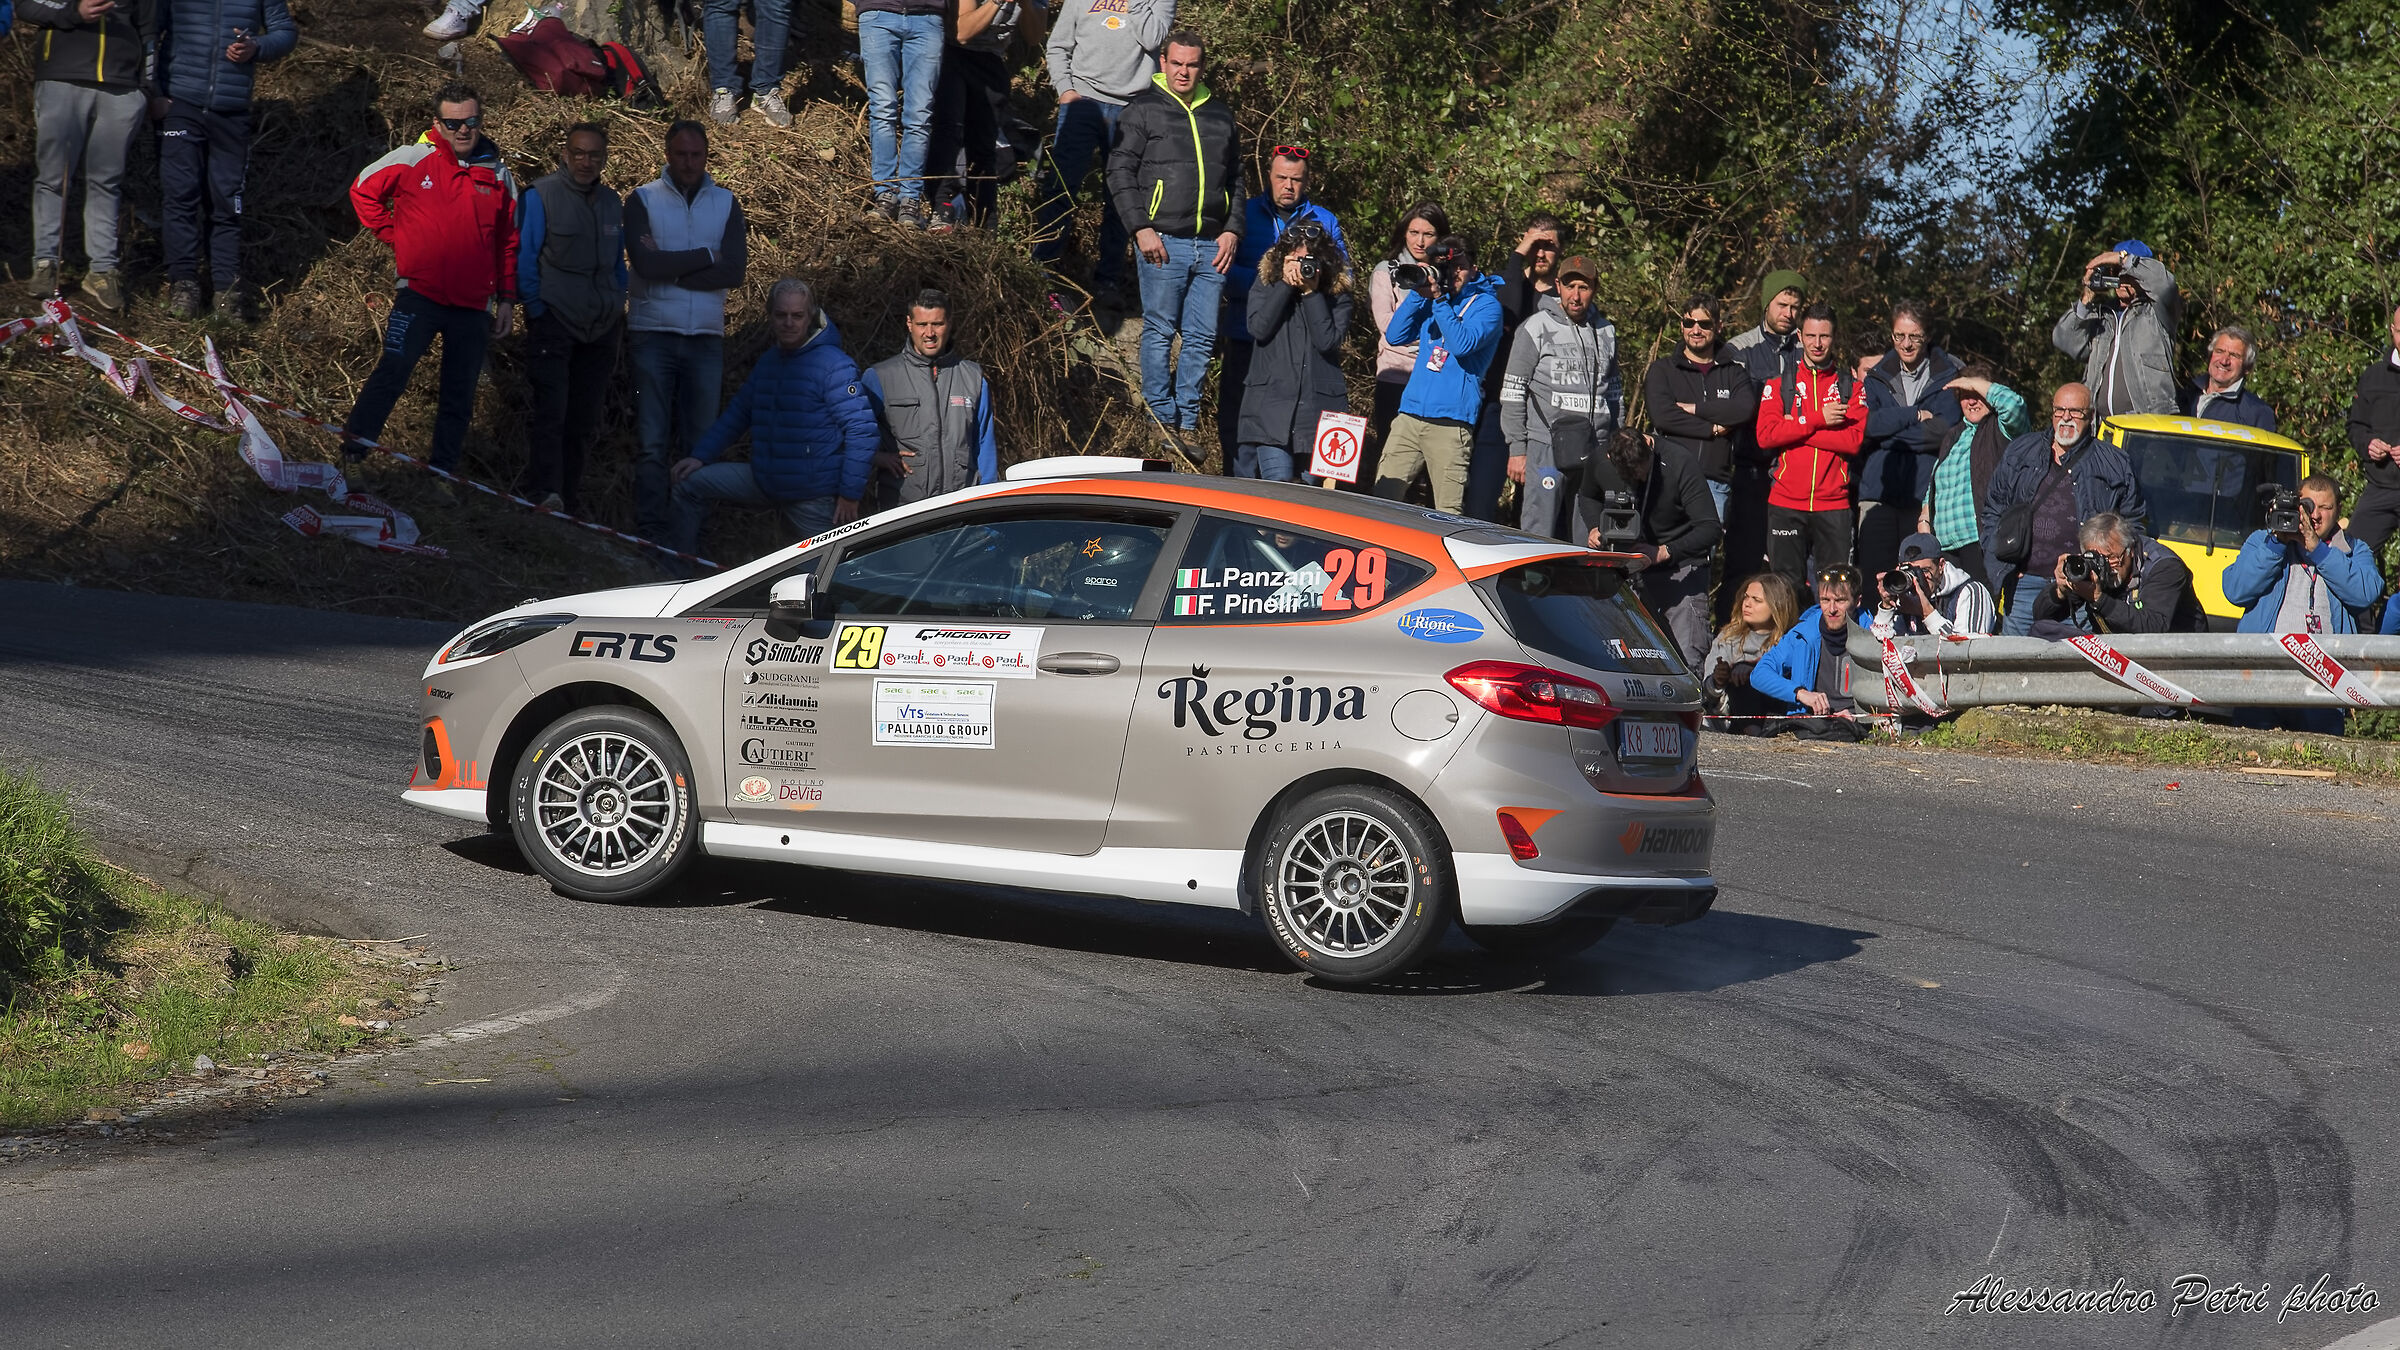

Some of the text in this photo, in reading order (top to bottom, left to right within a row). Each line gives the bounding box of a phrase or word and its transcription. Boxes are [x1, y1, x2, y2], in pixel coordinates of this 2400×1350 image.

[2171, 420, 2255, 440] 144
[1200, 567, 1321, 588] L.Panzani
[1321, 548, 1387, 611] 29
[1198, 595, 1215, 614] F.
[1224, 594, 1298, 614] Pinelli
[1416, 615, 1455, 631] Rione
[767, 643, 824, 665] SimCoVR
[834, 626, 885, 668] 29
[2070, 635, 2122, 673] PERICOLOSA
[2302, 638, 2325, 663] ZONA
[2284, 635, 2334, 685] PERICOLOSA
[760, 673, 811, 684] SUDGRANI
[2136, 672, 2179, 703] cioccorally.it
[900, 704, 924, 718] VTS
[1157, 676, 1368, 740] Regina
[748, 715, 816, 728] IL FARO
[887, 723, 988, 736] PALLADIO GROUP
[1186, 740, 1342, 756] PASTICCERIA
[1627, 725, 1679, 755] K8 3023
[781, 778, 824, 786] MOLINO
[779, 785, 822, 801] DeVita
